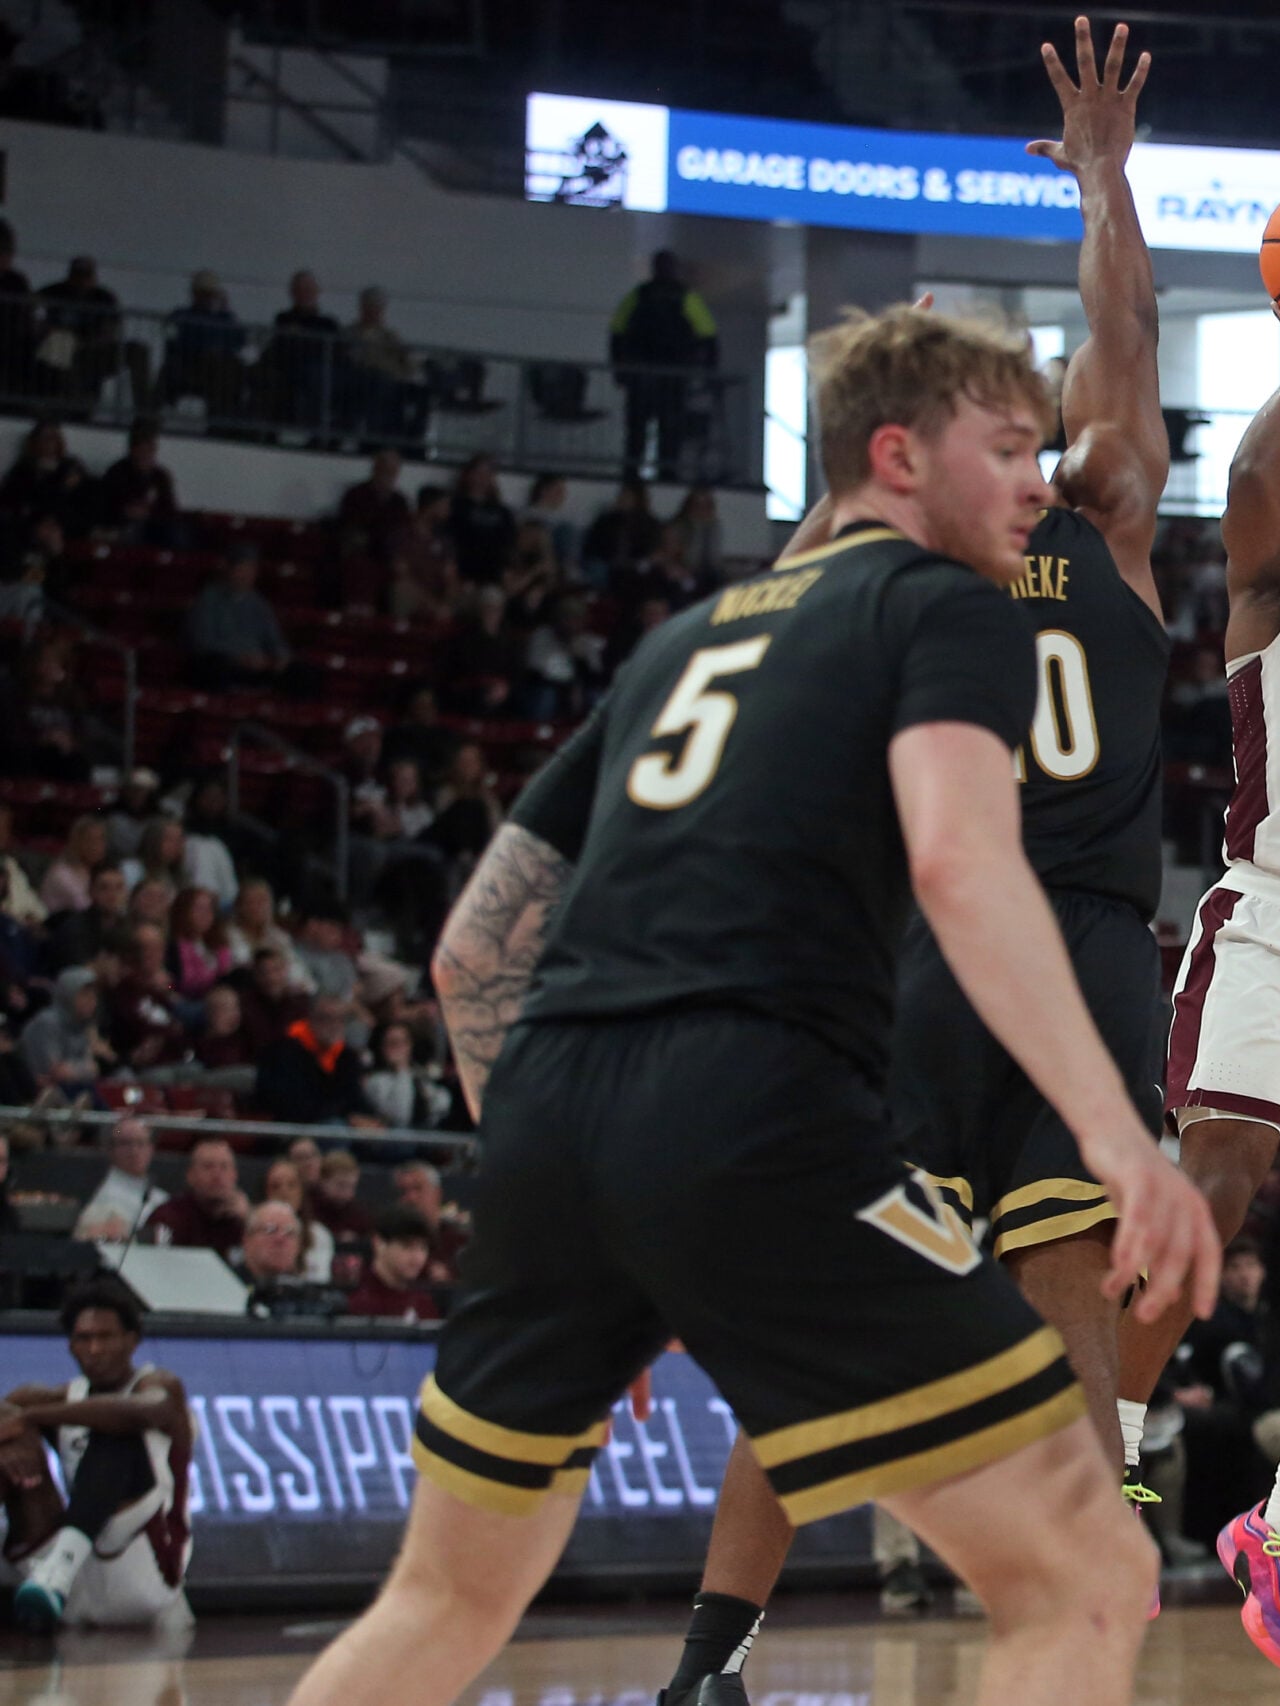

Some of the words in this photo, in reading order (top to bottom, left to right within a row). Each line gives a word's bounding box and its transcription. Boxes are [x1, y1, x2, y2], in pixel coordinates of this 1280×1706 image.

[677, 144, 805, 190] GARAGE
[808, 158, 919, 200] DOORS
[923, 167, 952, 202] &
[956, 168, 1081, 209] SERVIC
[626, 633, 773, 811] 5
[1012, 628, 1101, 784] 0
[188, 1396, 420, 1512] ISSIPP
